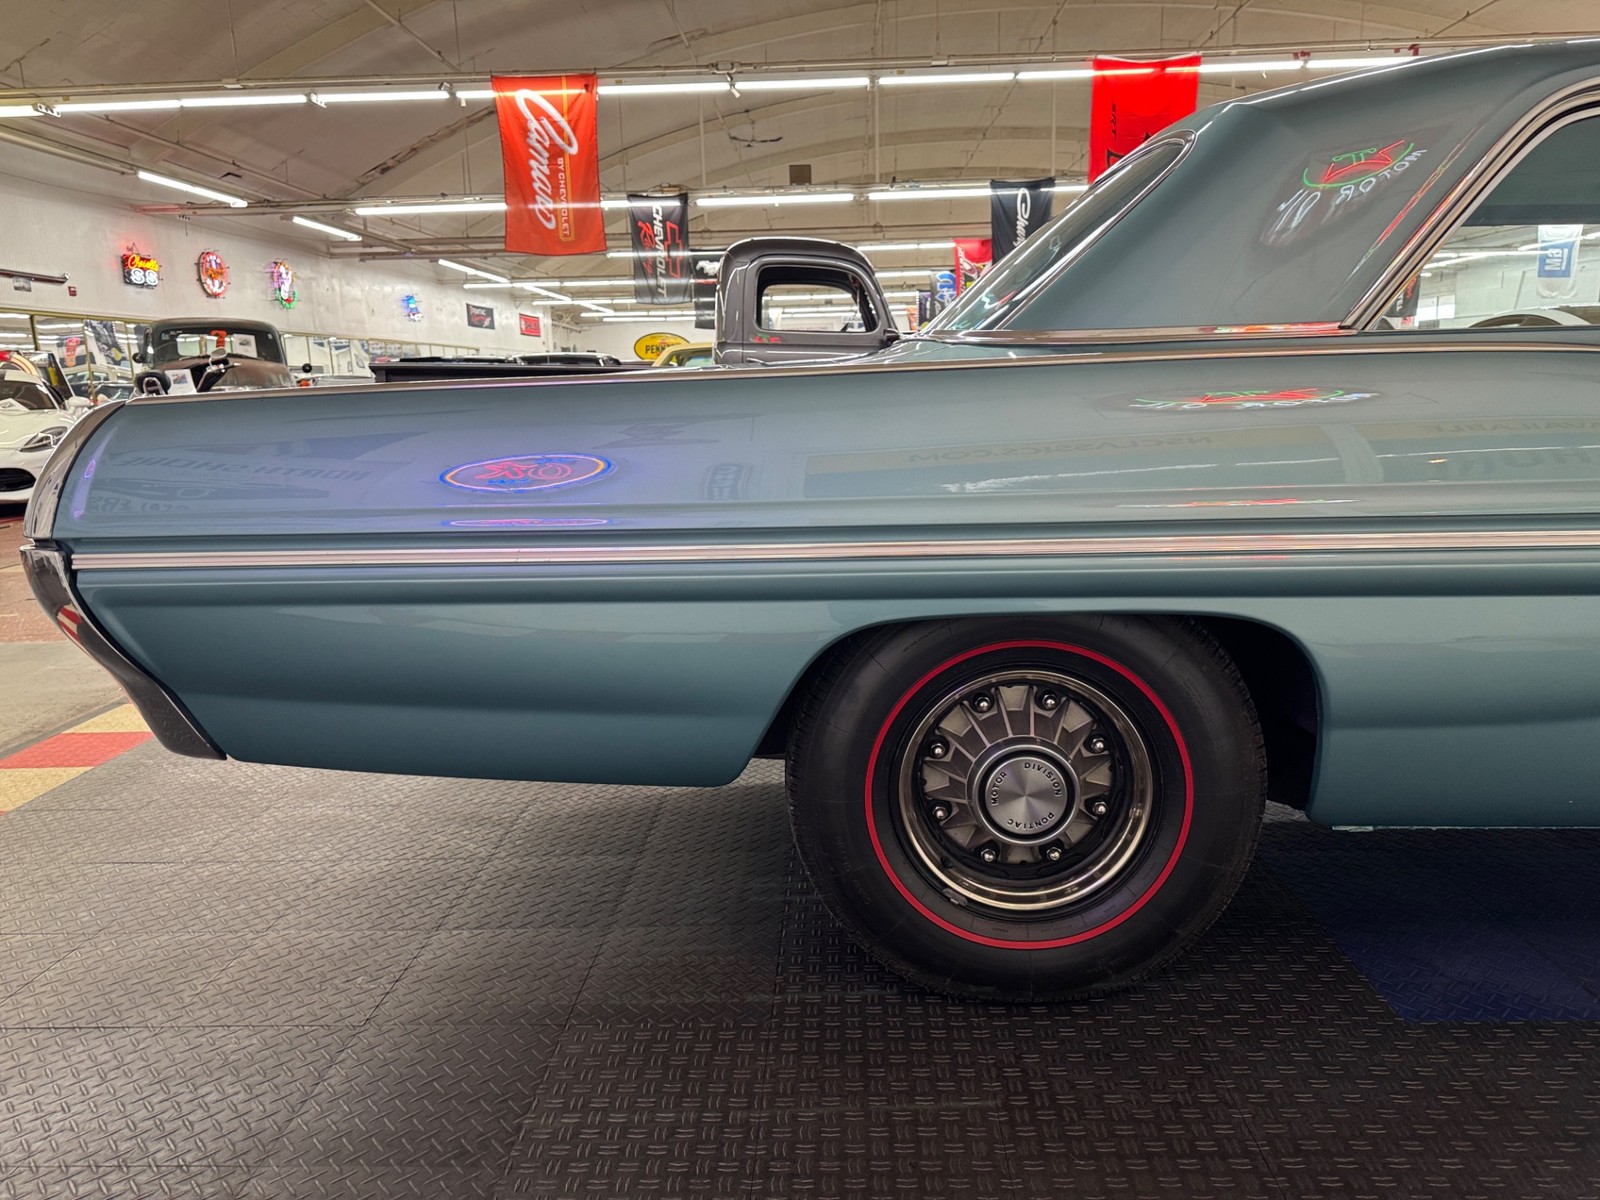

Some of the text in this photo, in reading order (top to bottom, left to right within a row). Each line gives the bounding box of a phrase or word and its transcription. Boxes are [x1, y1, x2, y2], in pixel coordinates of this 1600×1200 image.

[515, 89, 578, 230] Camaro
[557, 157, 570, 236] BY CHEVROLET
[130, 268, 158, 286] SS
[651, 205, 668, 298] CHEVROLET
[645, 343, 682, 355] PENN
[991, 762, 1062, 829] PONTIAC MOTOR DIVISION
